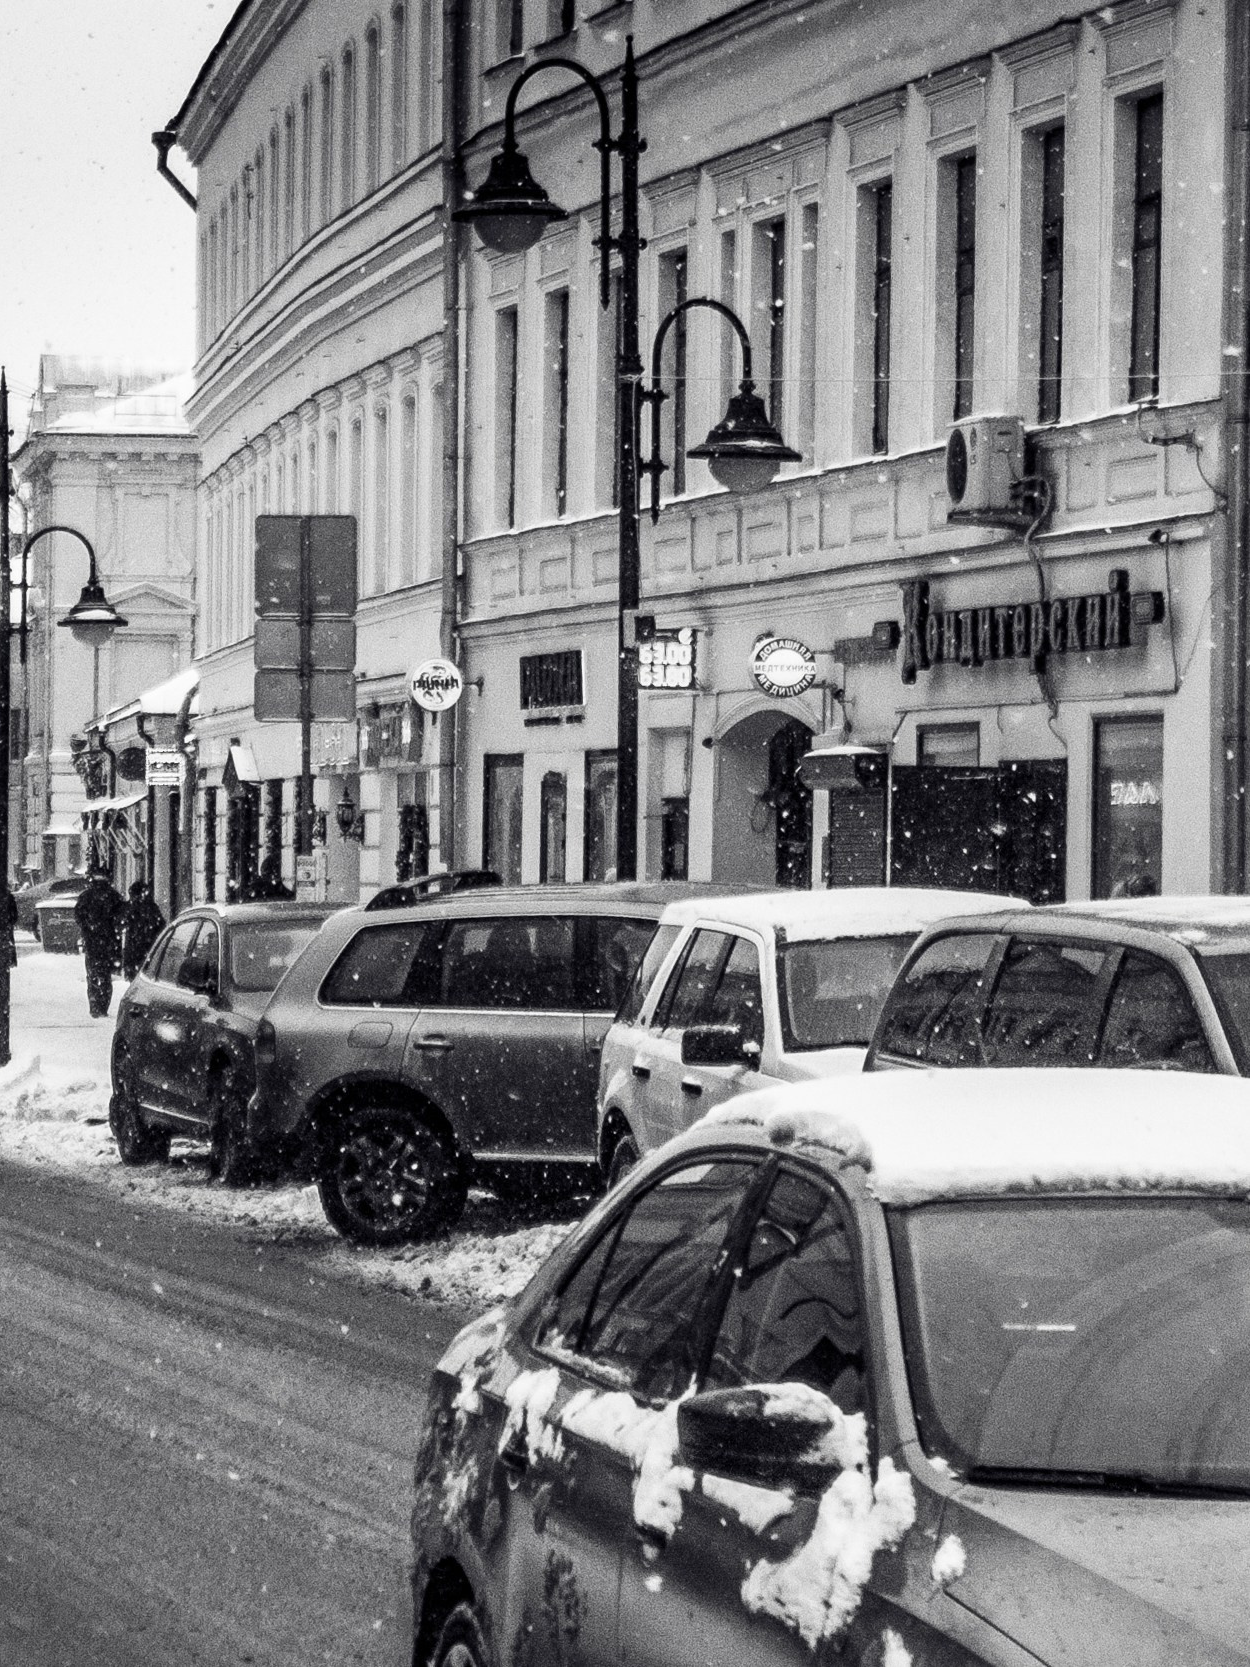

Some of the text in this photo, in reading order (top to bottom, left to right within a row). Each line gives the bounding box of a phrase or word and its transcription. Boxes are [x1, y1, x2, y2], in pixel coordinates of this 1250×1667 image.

[758, 639, 812, 661] ДОМАШНЯЯ
[755, 664, 816, 674] МЕДТЕХНИКА
[758, 673, 814, 697] МЕДИЦИНА
